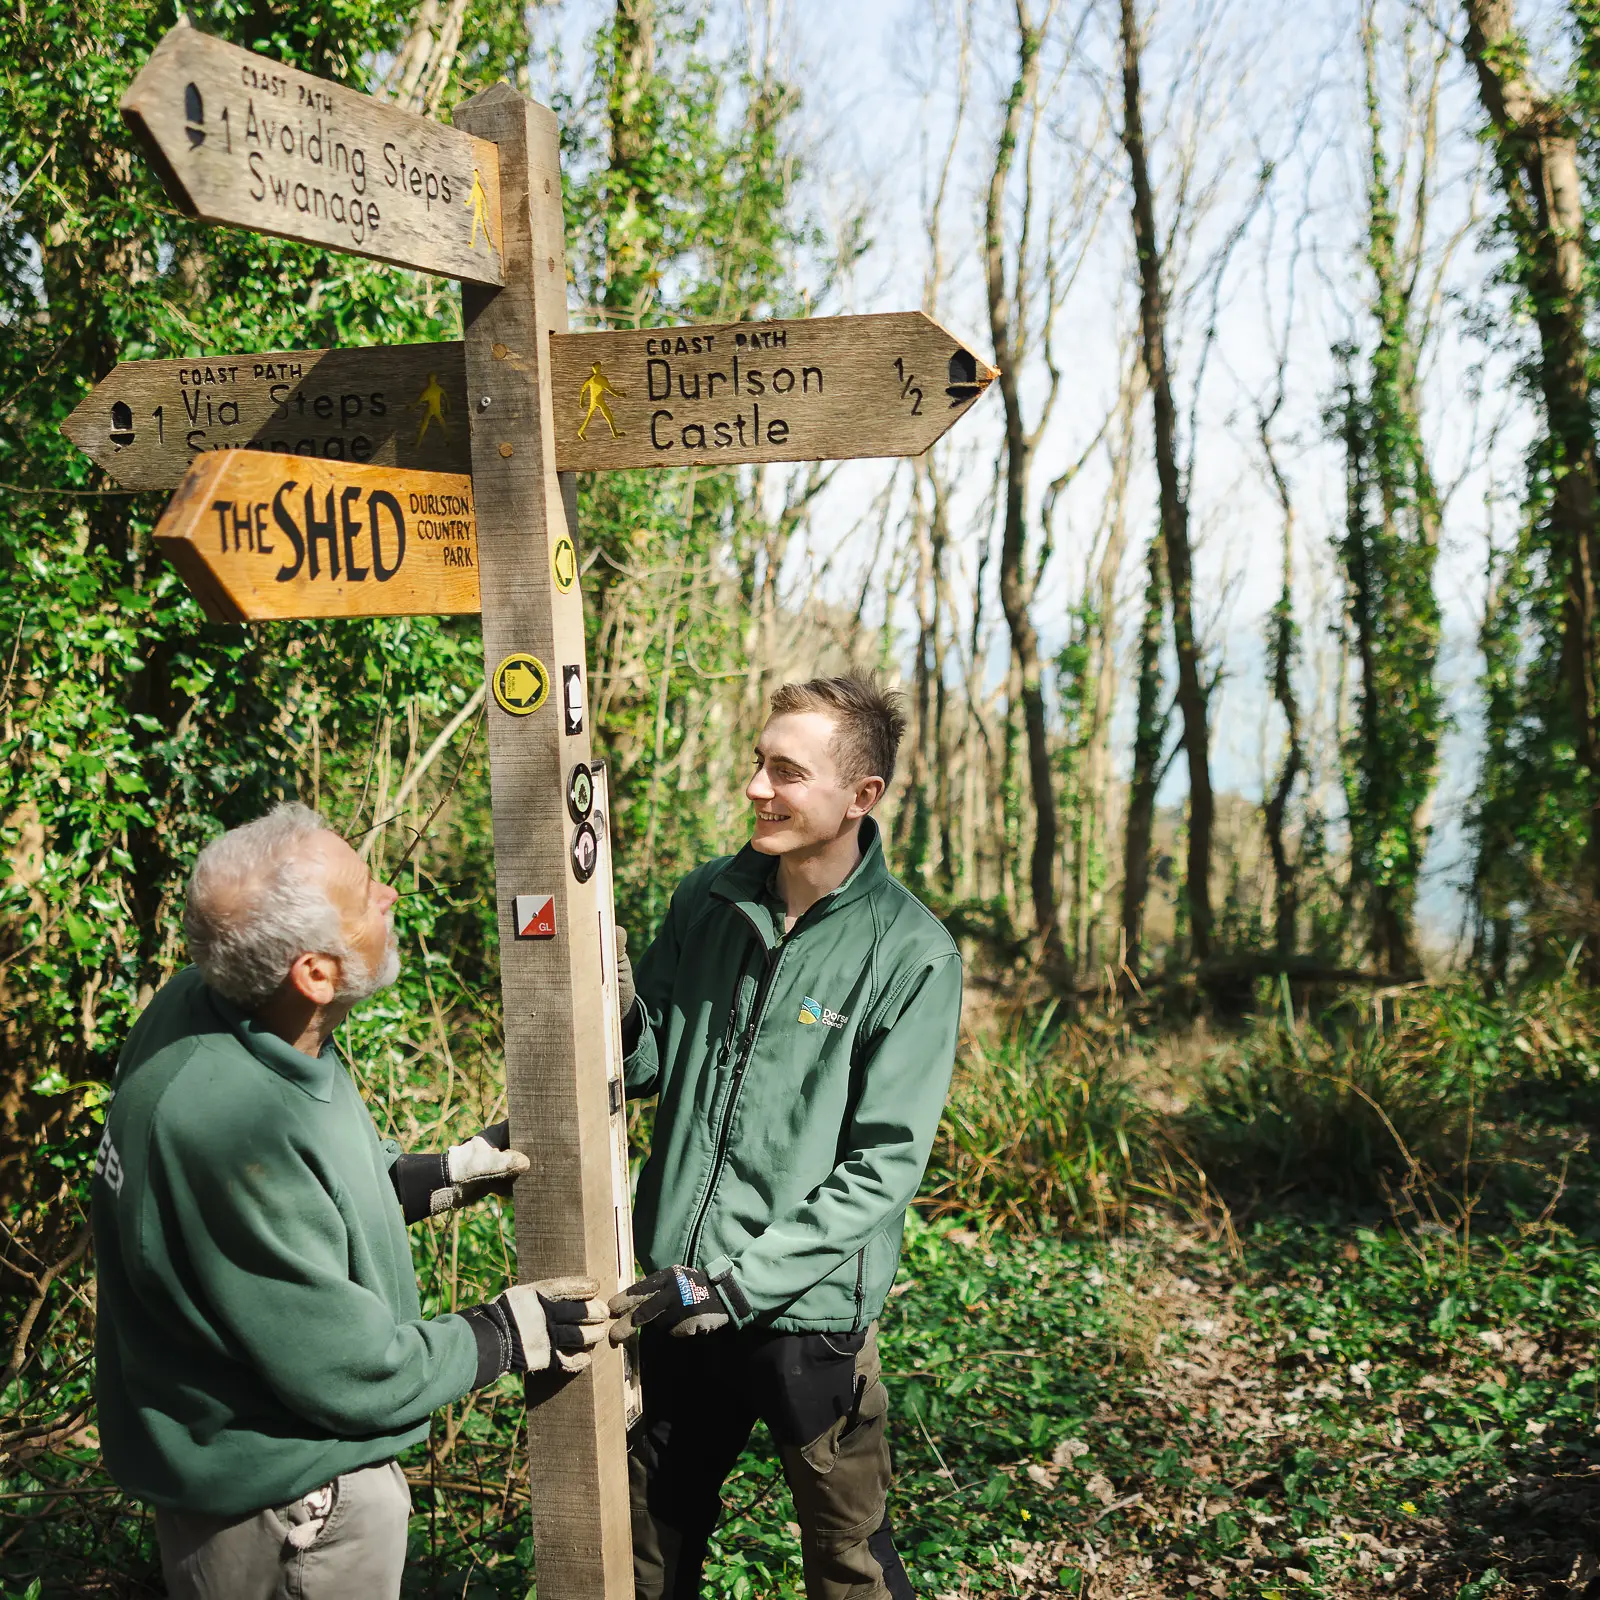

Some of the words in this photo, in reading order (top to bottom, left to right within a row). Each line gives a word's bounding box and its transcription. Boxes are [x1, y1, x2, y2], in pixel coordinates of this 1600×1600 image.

[241, 65, 287, 98] COAST
[297, 84, 333, 117] PATH
[220, 105, 233, 155] 1
[245, 97, 366, 196] Avoiding
[383, 142, 453, 212] Steps
[248, 151, 382, 245] Swanage
[646, 335, 715, 356] COAST
[735, 330, 787, 351] PATH
[179, 366, 239, 386] COAST
[254, 363, 303, 381] PATH
[646, 355, 825, 401] Durlson
[152, 405, 164, 445] 1
[180, 388, 240, 427] Via
[269, 384, 387, 430] Steps
[650, 403, 790, 450] Castle
[185, 430, 374, 466] Sage
[409, 493, 470, 516] DURLSTON
[211, 501, 274, 555] THE
[272, 480, 406, 583] SHED
[417, 520, 471, 540] COUNTRY
[443, 546, 474, 567] PARK
[538, 922, 552, 932] GL
